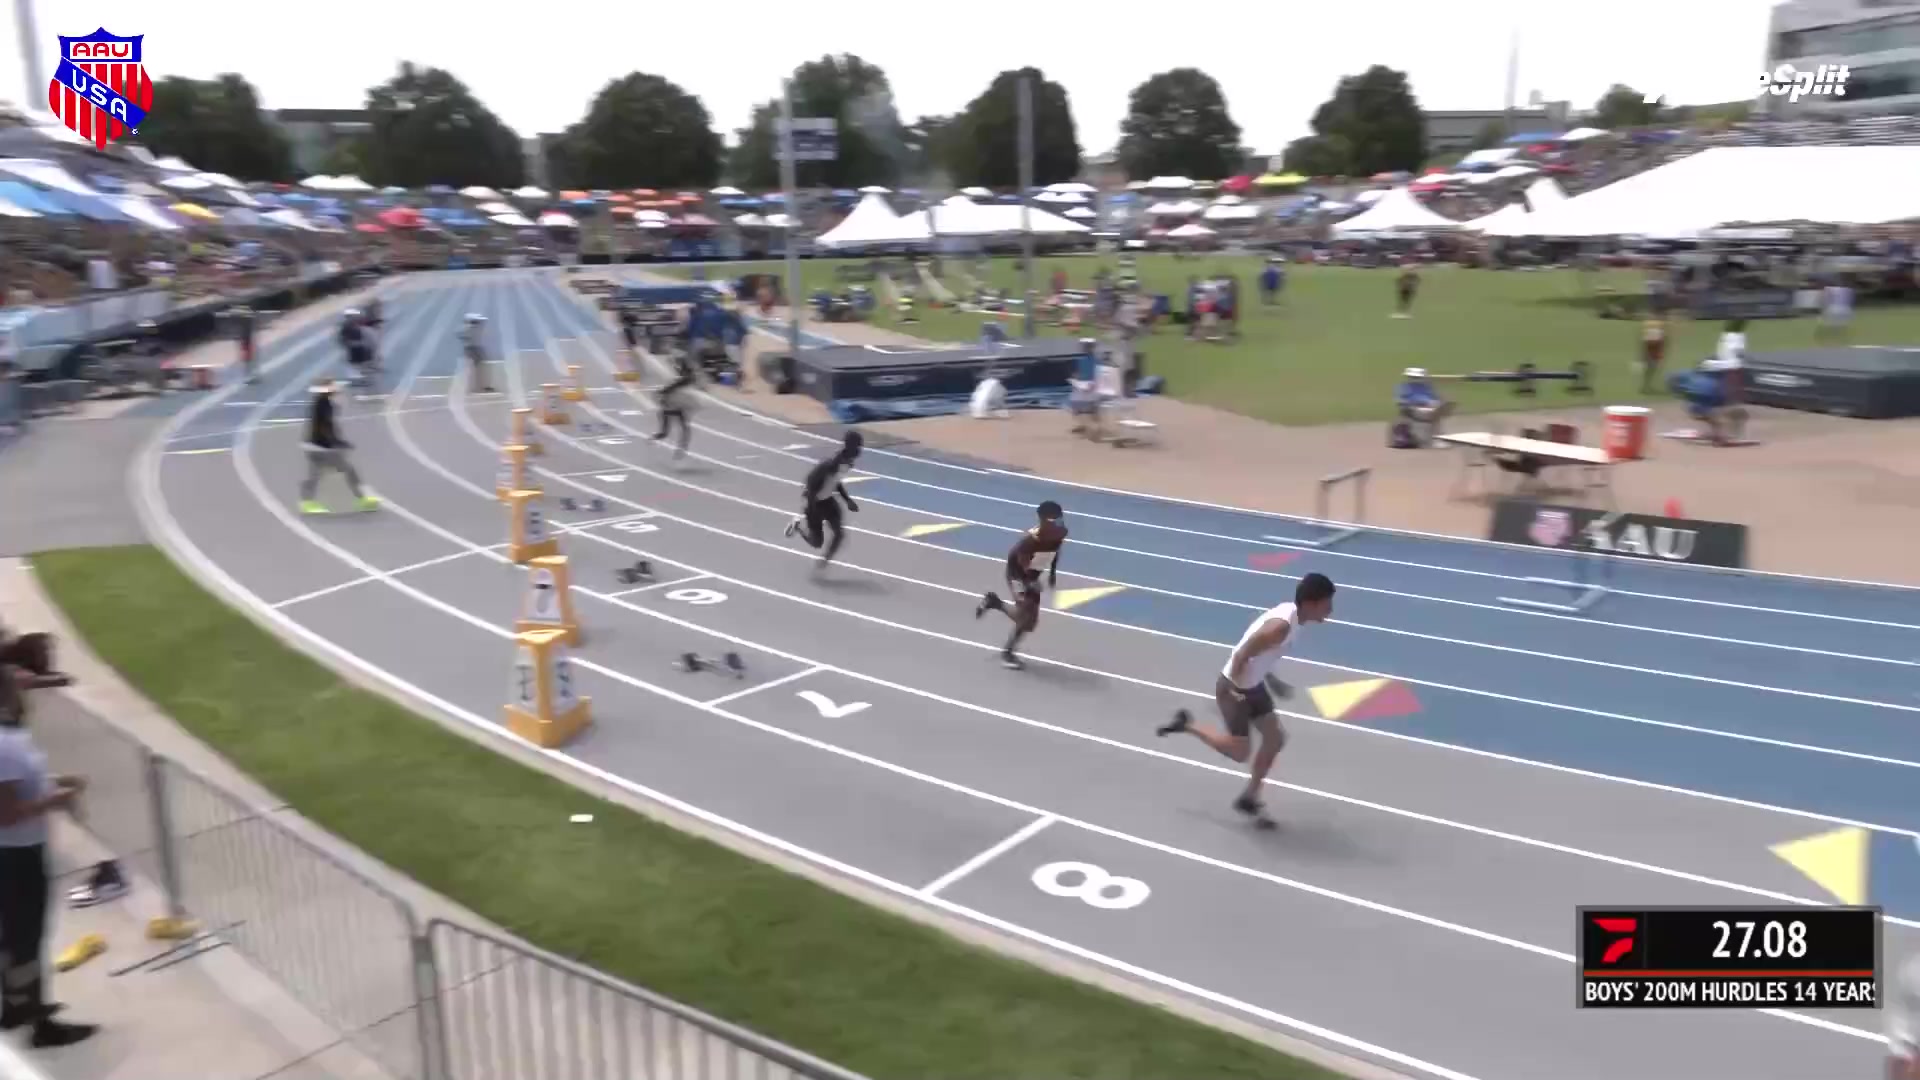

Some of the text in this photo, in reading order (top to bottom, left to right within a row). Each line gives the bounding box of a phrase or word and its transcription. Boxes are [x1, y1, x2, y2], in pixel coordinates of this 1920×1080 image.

[664, 588, 729, 605] 6
[796, 690, 873, 718] 7
[1031, 861, 1152, 910] 8
